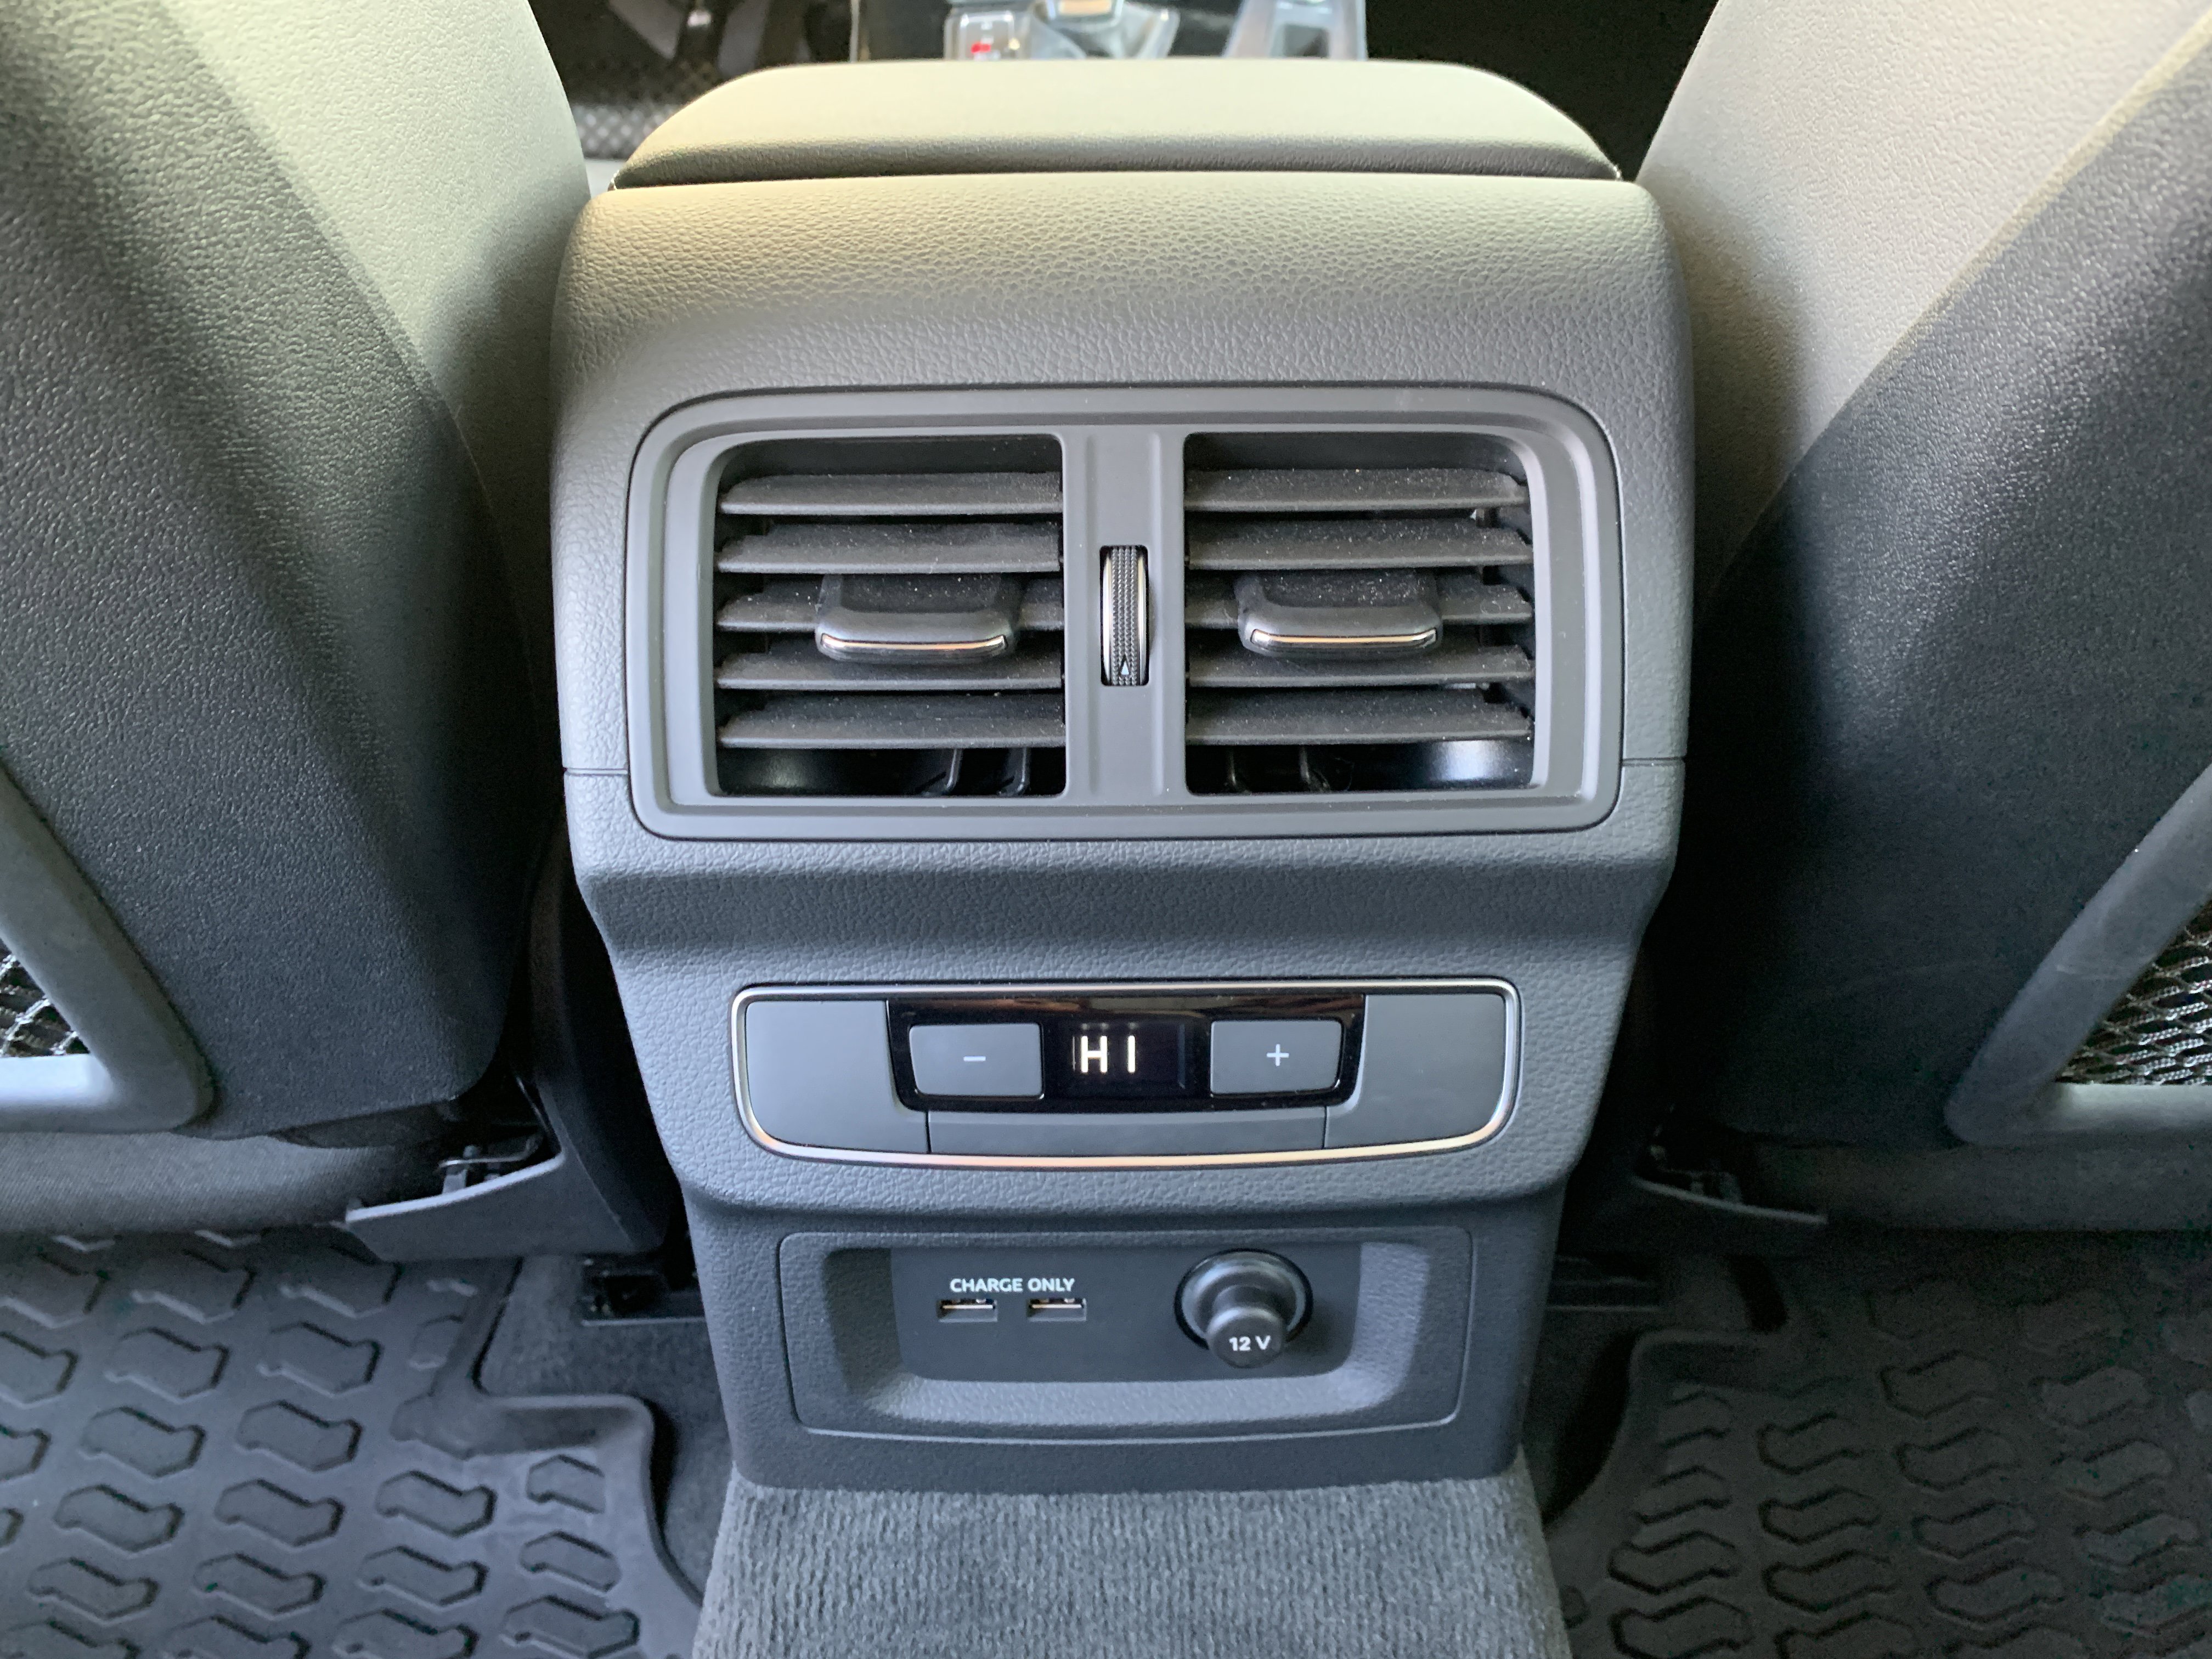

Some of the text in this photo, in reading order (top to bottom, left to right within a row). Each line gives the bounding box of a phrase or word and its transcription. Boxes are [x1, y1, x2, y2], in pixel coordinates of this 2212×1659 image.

[1080, 1035, 1136, 1073] HI
[949, 1278, 1075, 1293] CHARGE ONLY
[1229, 1335, 1271, 1351] 12 V
